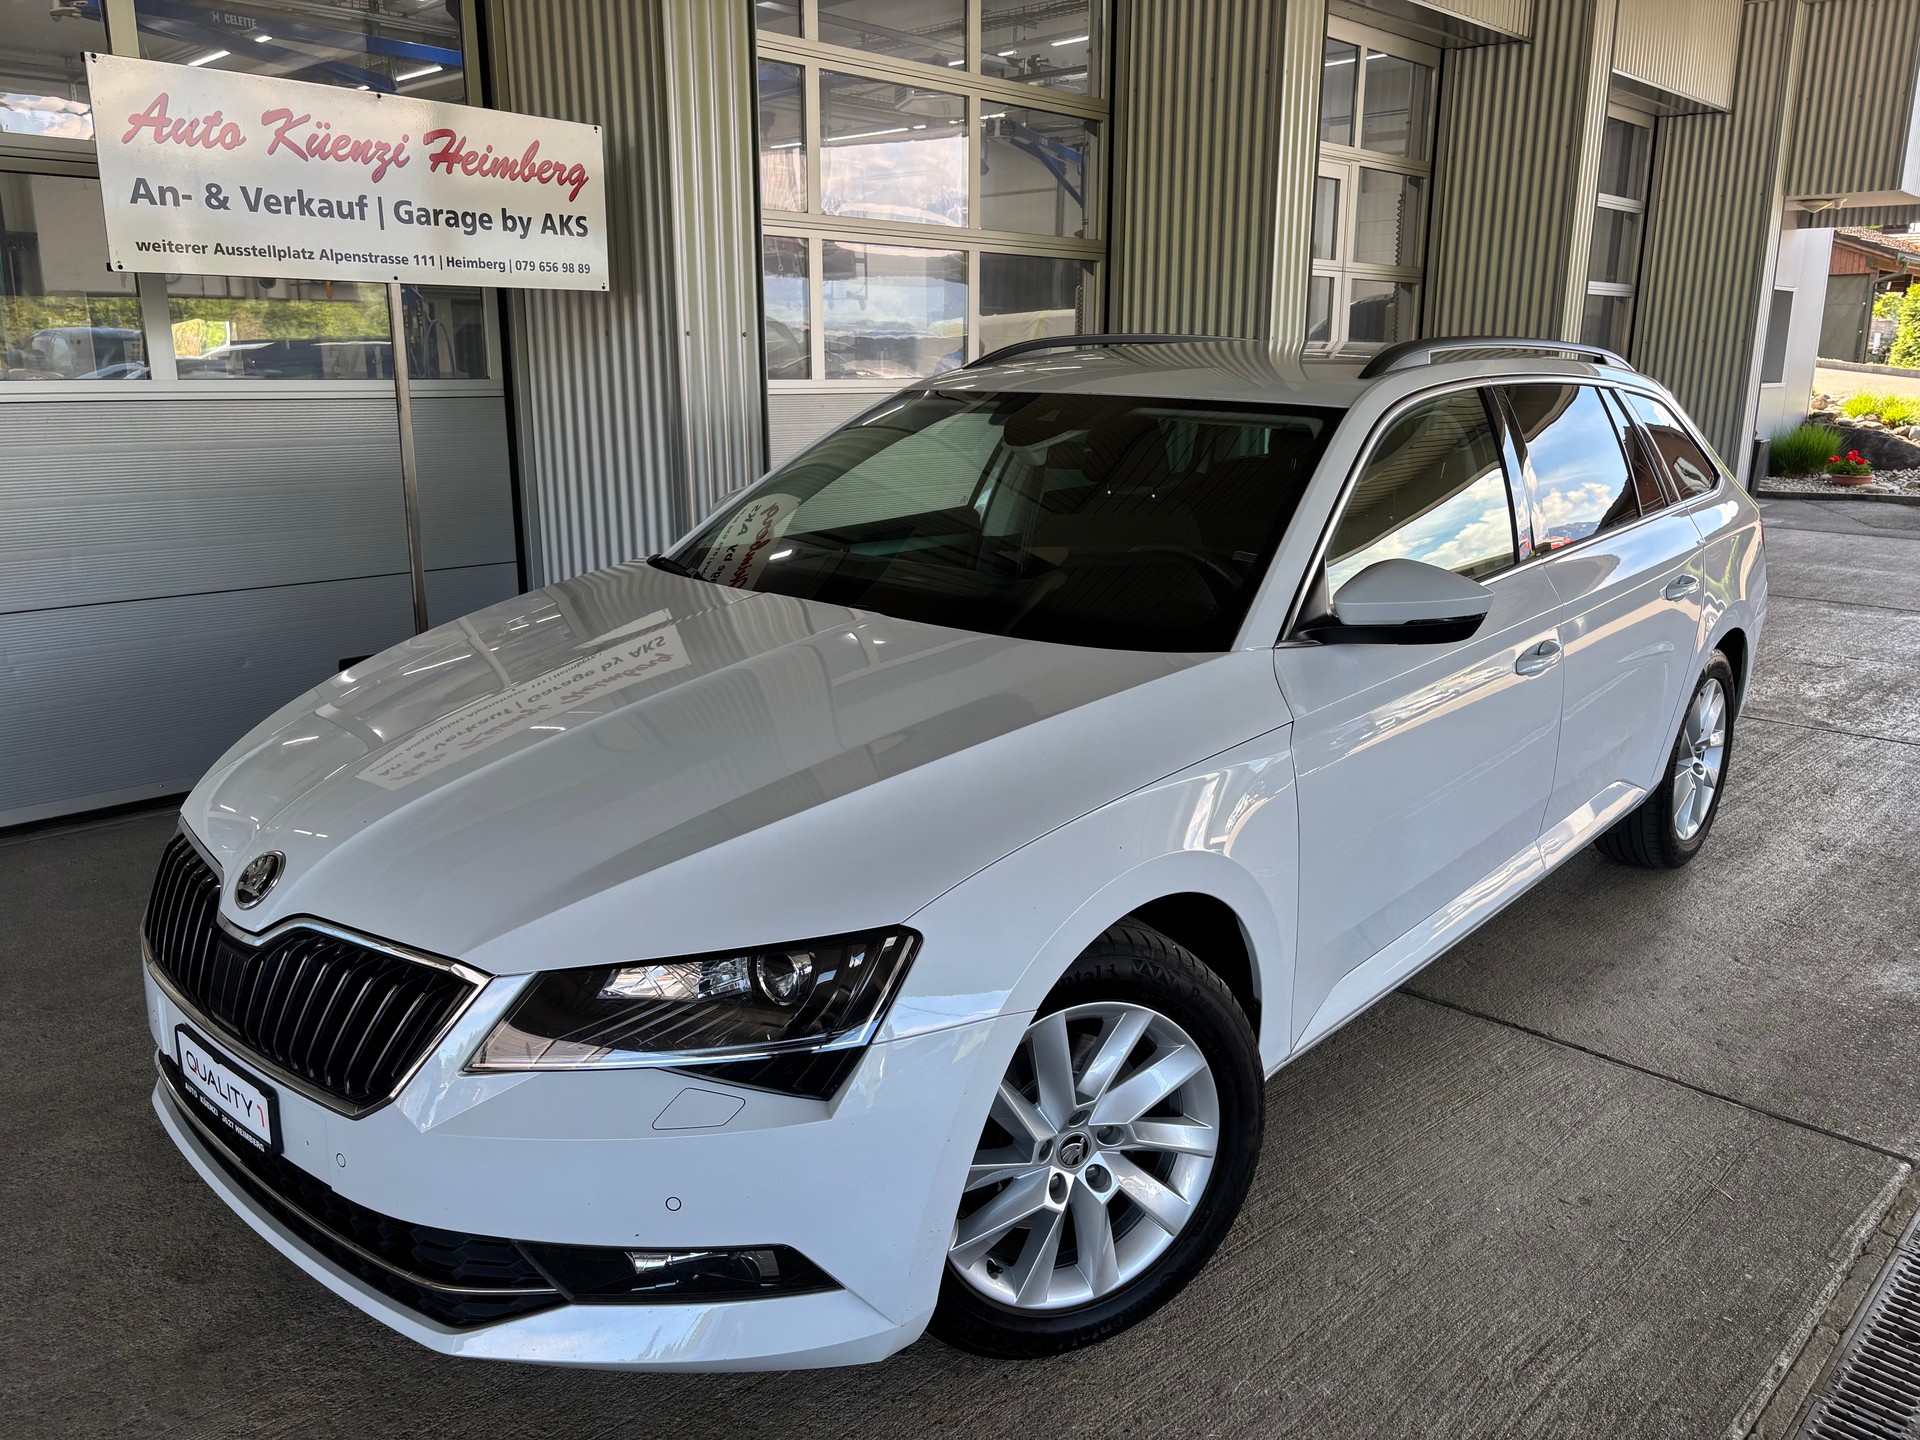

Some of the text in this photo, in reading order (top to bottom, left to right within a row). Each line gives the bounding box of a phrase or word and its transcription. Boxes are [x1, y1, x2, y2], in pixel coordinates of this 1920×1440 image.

[224, 14, 257, 28] CELETTE
[121, 92, 589, 202] Auto Küenzi Heimberg
[129, 177, 192, 207] An-
[204, 183, 231, 211] &
[239, 185, 368, 221] Verkauf
[393, 200, 493, 236] Garage
[501, 207, 532, 239] by
[541, 212, 588, 237] AKS
[135, 239, 208, 255] weiterer
[213, 242, 315, 261] Ausstellplatz
[319, 248, 409, 266] Alpenstrasse
[413, 254, 435, 267] 111
[446, 256, 506, 272] Heimberg
[515, 260, 535, 272] 079
[539, 261, 559, 272] 656
[562, 262, 575, 273] 98
[578, 263, 591, 274] 89
[185, 1050, 265, 1128] QUALITY 1
